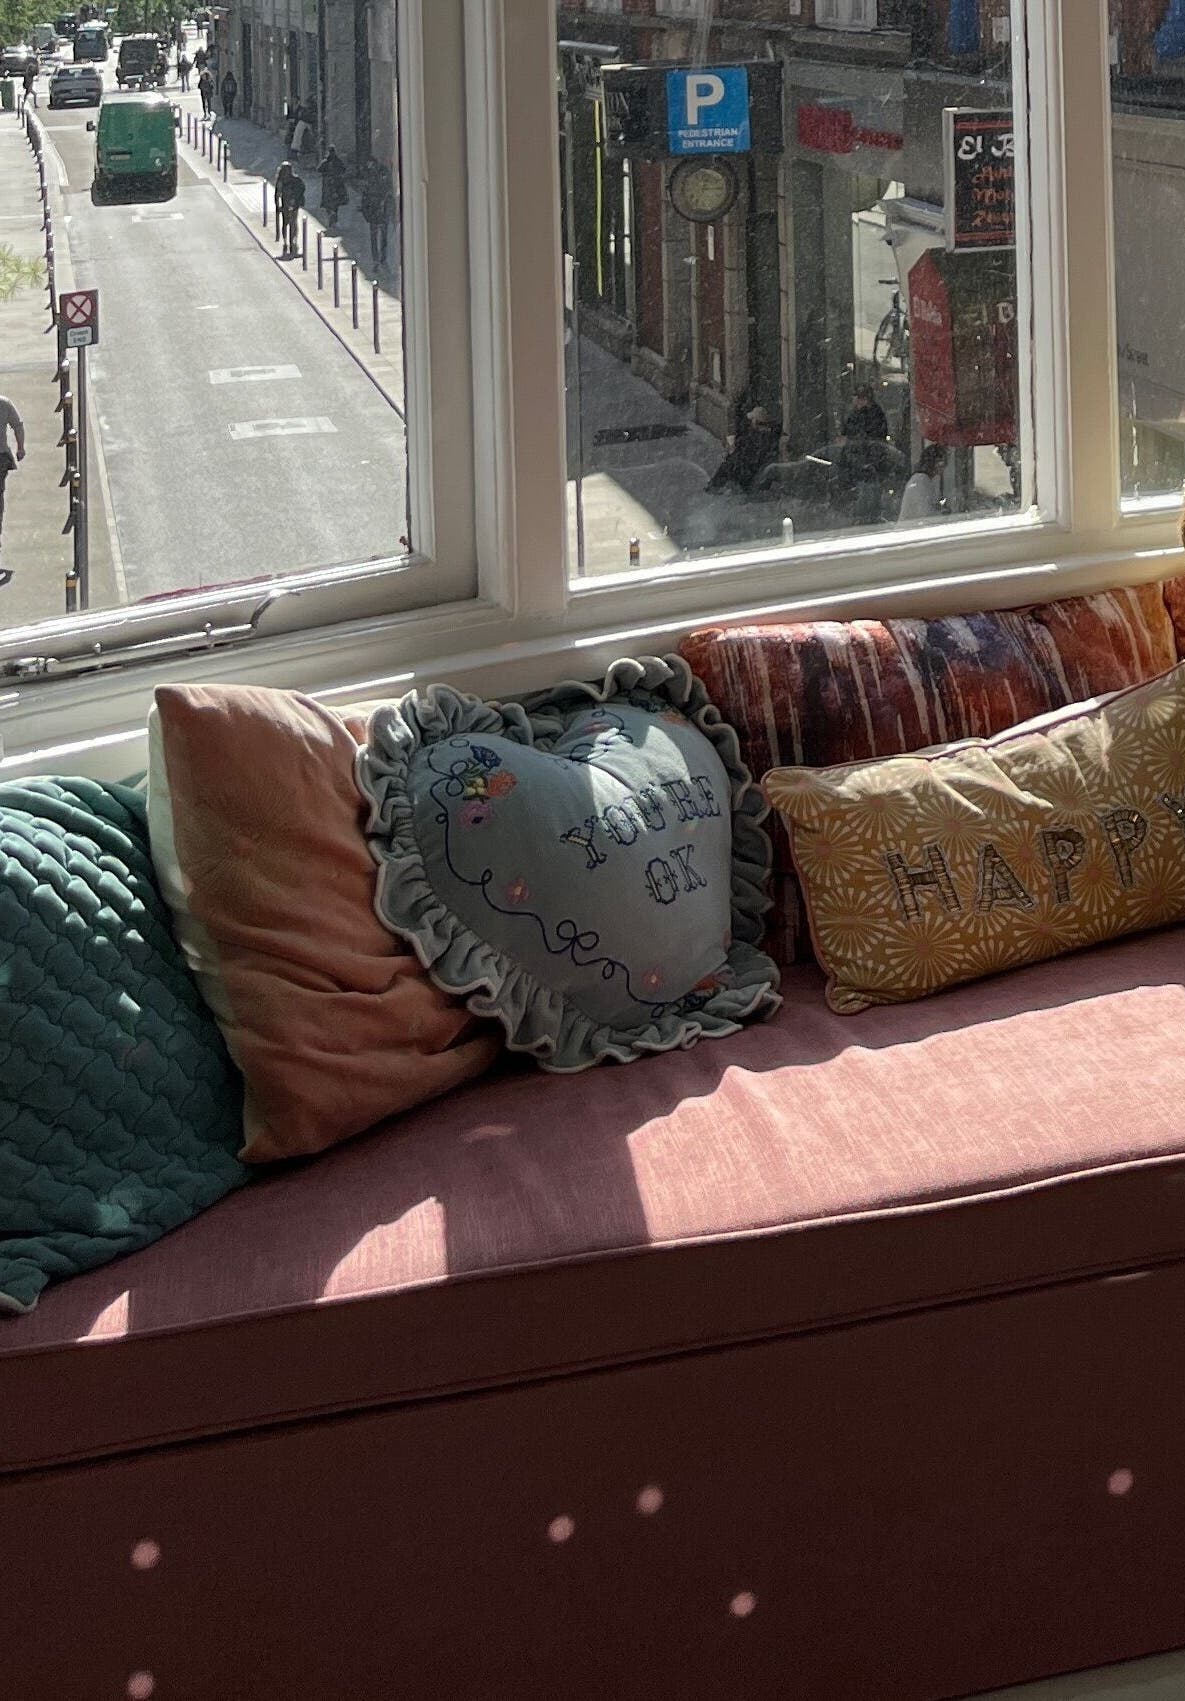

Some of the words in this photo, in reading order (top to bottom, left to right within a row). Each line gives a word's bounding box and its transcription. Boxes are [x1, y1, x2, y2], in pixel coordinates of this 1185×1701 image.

[686, 74, 725, 125] P
[678, 128, 738, 138] PEDESTRIAN
[682, 138, 734, 149] ENTRANCE
[645, 844, 707, 905] OK
